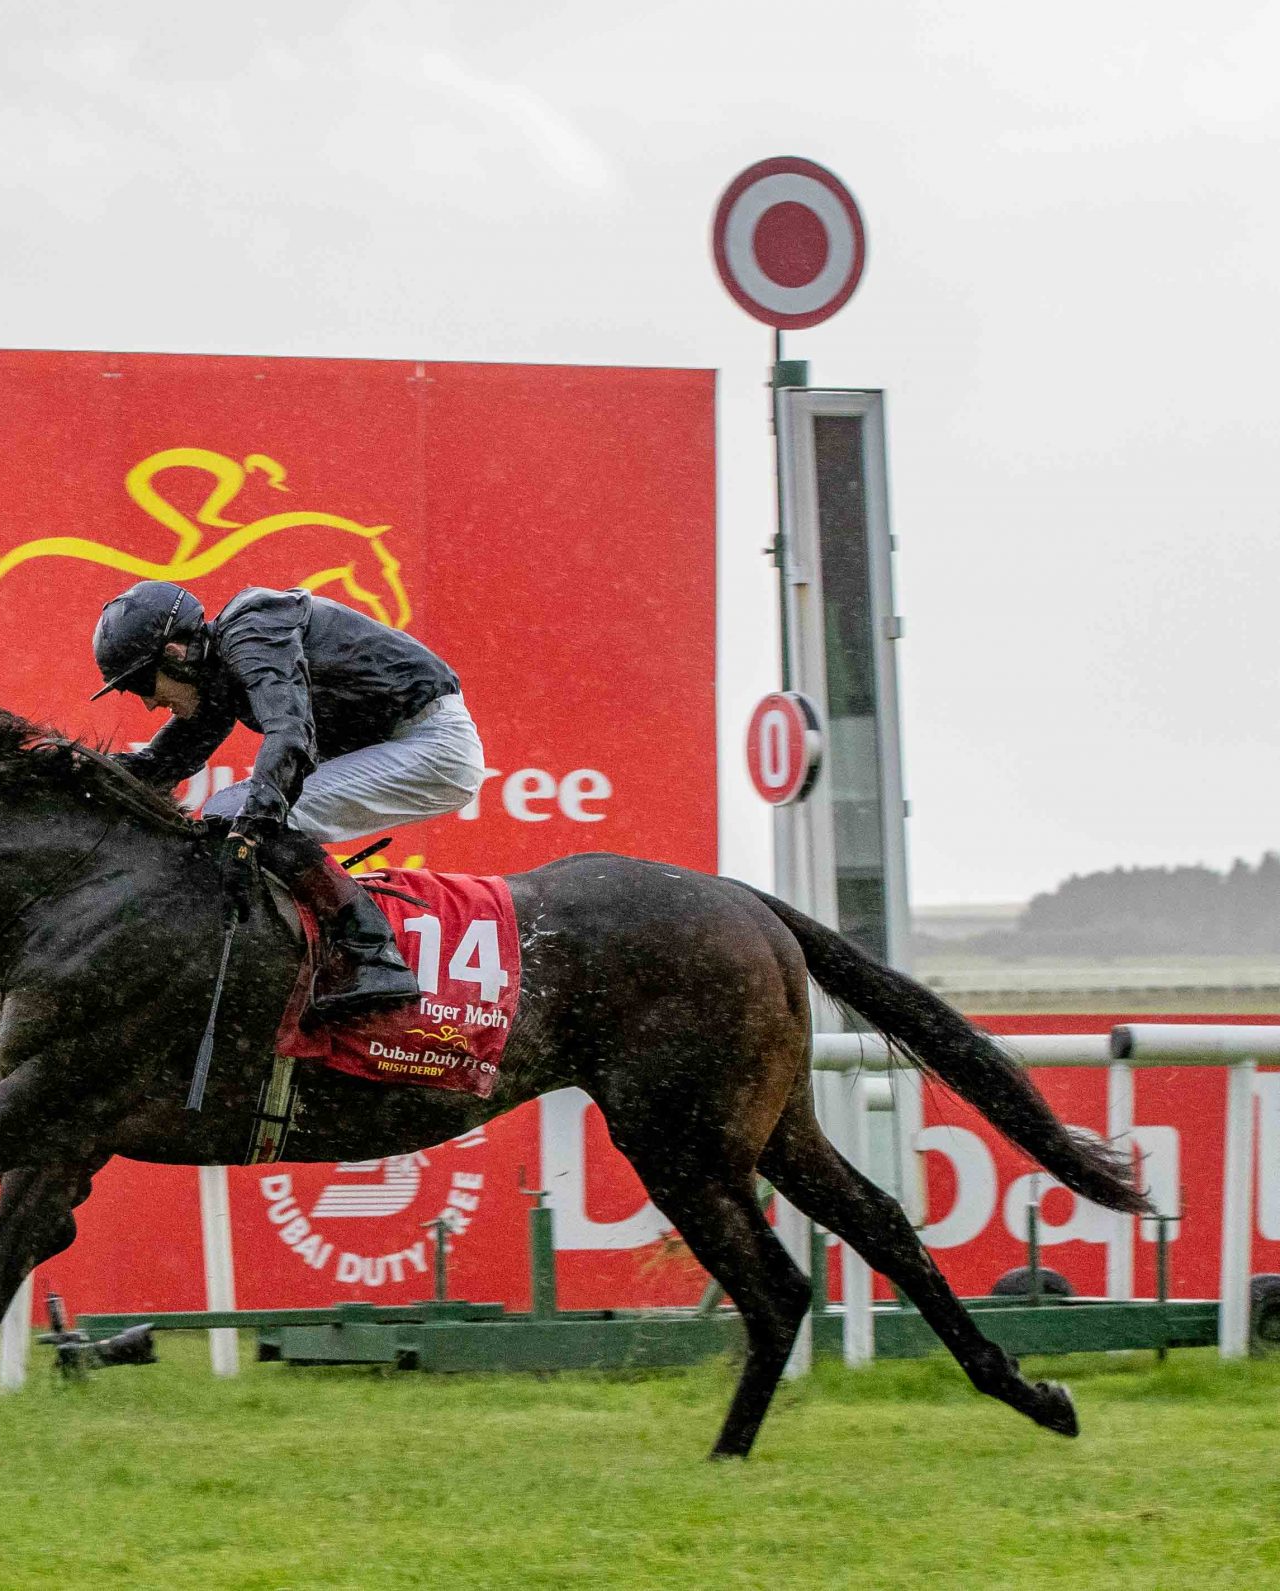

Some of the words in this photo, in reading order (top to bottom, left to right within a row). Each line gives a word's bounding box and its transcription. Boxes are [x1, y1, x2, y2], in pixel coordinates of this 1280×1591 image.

[458, 767, 613, 822] ree
[404, 914, 508, 1004] 14
[465, 1004, 508, 1029] Moth
[370, 1041, 420, 1062] Dubai
[423, 1050, 460, 1069] Duty
[463, 1056, 497, 1076] Free
[377, 1060, 406, 1073] IRISH
[409, 1065, 445, 1077] DERBY
[259, 1173, 334, 1270] DUBAI
[335, 1242, 428, 1287] DUTY
